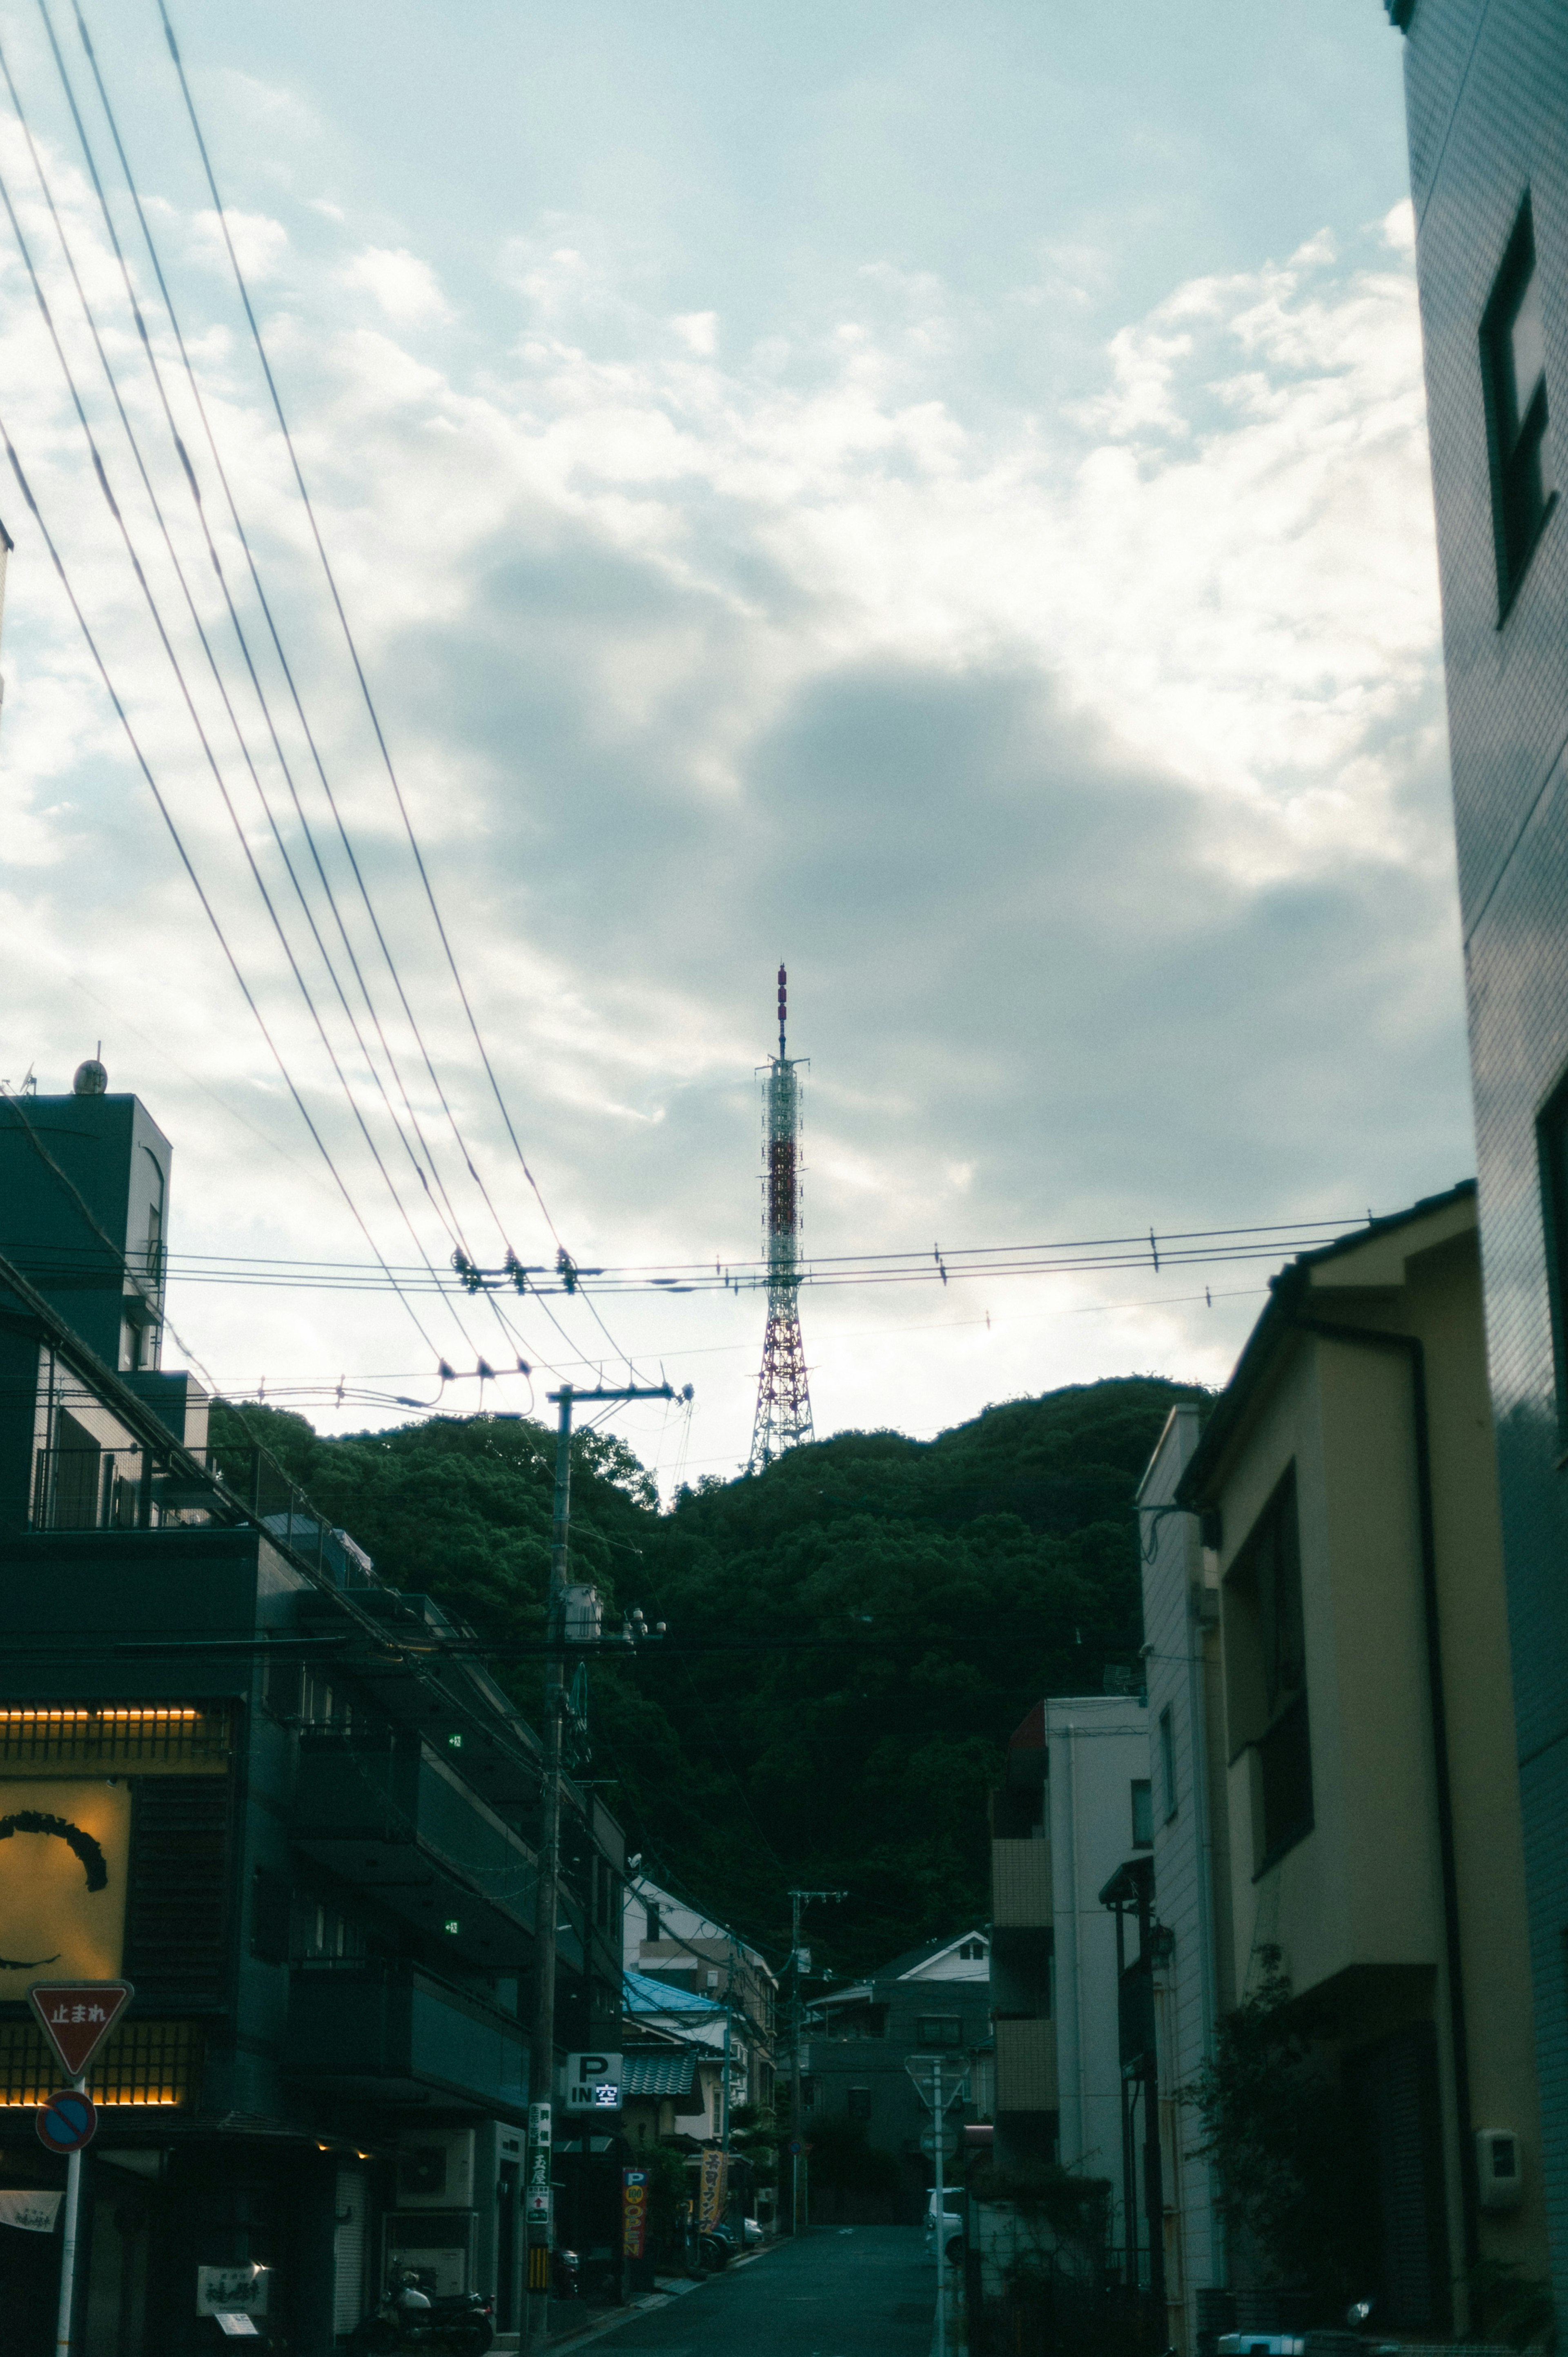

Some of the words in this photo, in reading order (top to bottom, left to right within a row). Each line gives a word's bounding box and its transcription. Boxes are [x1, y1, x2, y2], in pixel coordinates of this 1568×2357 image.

[51, 2004, 107, 2024] 止まれ
[580, 2056, 608, 2083] P
[572, 2087, 592, 2102] IN
[595, 2083, 618, 2106] 空
[531, 2154, 547, 2185] 玉屋
[628, 2173, 644, 2185] P
[623, 2205, 643, 2256] OPEN
